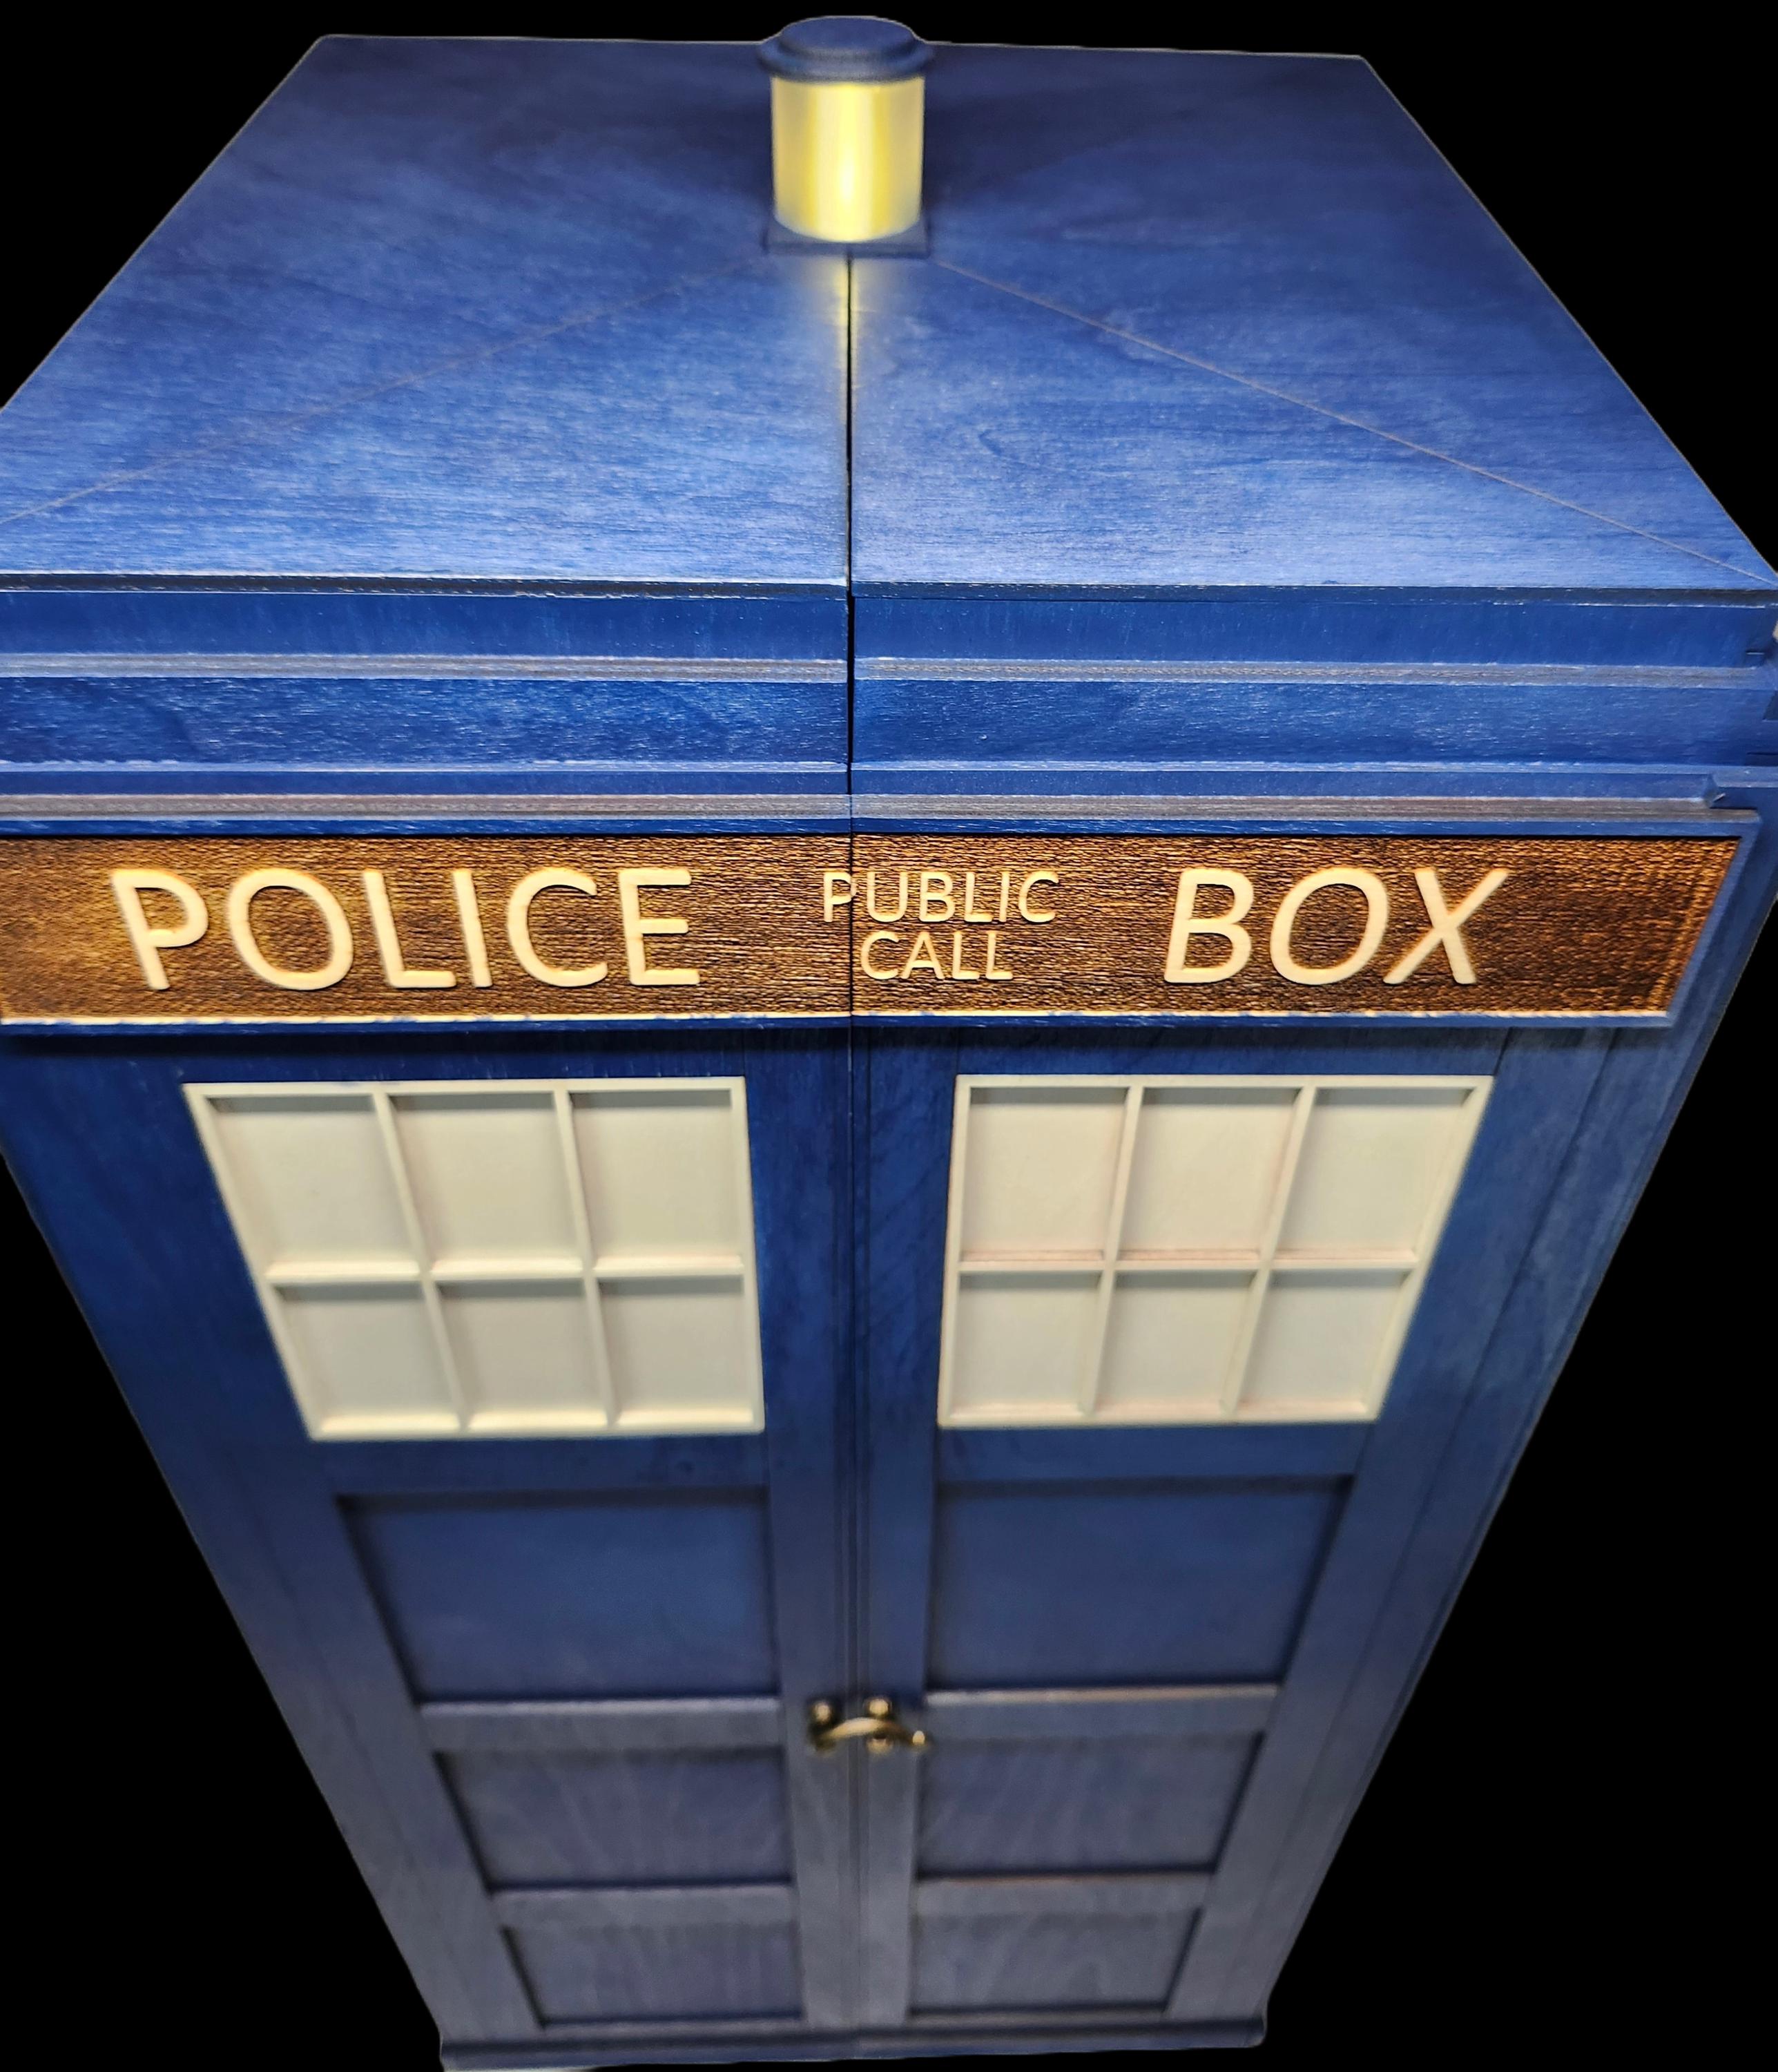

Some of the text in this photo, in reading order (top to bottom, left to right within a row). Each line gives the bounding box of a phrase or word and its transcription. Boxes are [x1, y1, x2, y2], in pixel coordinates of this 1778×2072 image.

[109, 867, 700, 990] POLICE
[823, 871, 1059, 923] PUBLIC
[1164, 867, 1509, 985] BOX
[860, 930, 1014, 980] CALL
